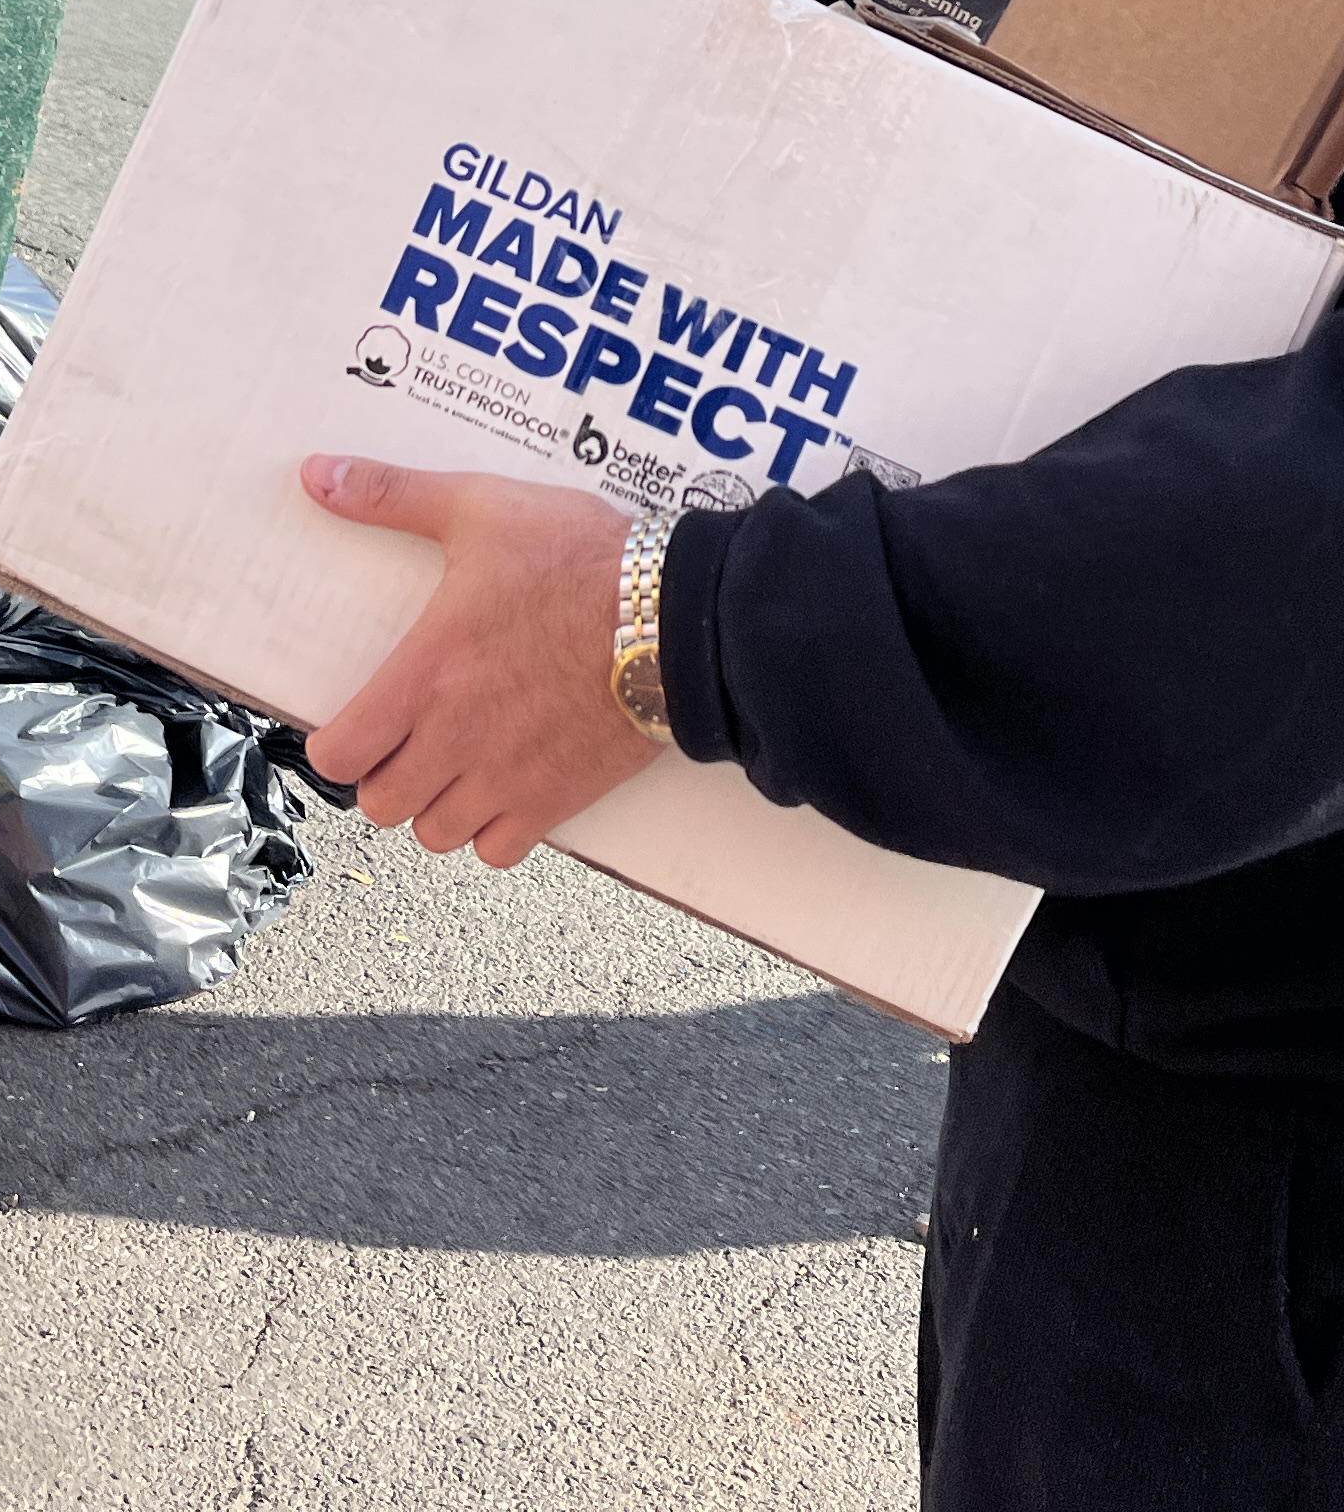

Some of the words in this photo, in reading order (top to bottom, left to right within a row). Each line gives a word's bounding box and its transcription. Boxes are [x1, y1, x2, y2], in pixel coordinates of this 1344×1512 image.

[443, 142, 624, 245] GILDAN
[412, 182, 649, 326] MADE
[658, 282, 859, 419] WITH
[413, 366, 464, 400] TRUST
[420, 346, 451, 372] U.S.
[456, 361, 532, 406] COTTON
[606, 461, 676, 503] cotton
